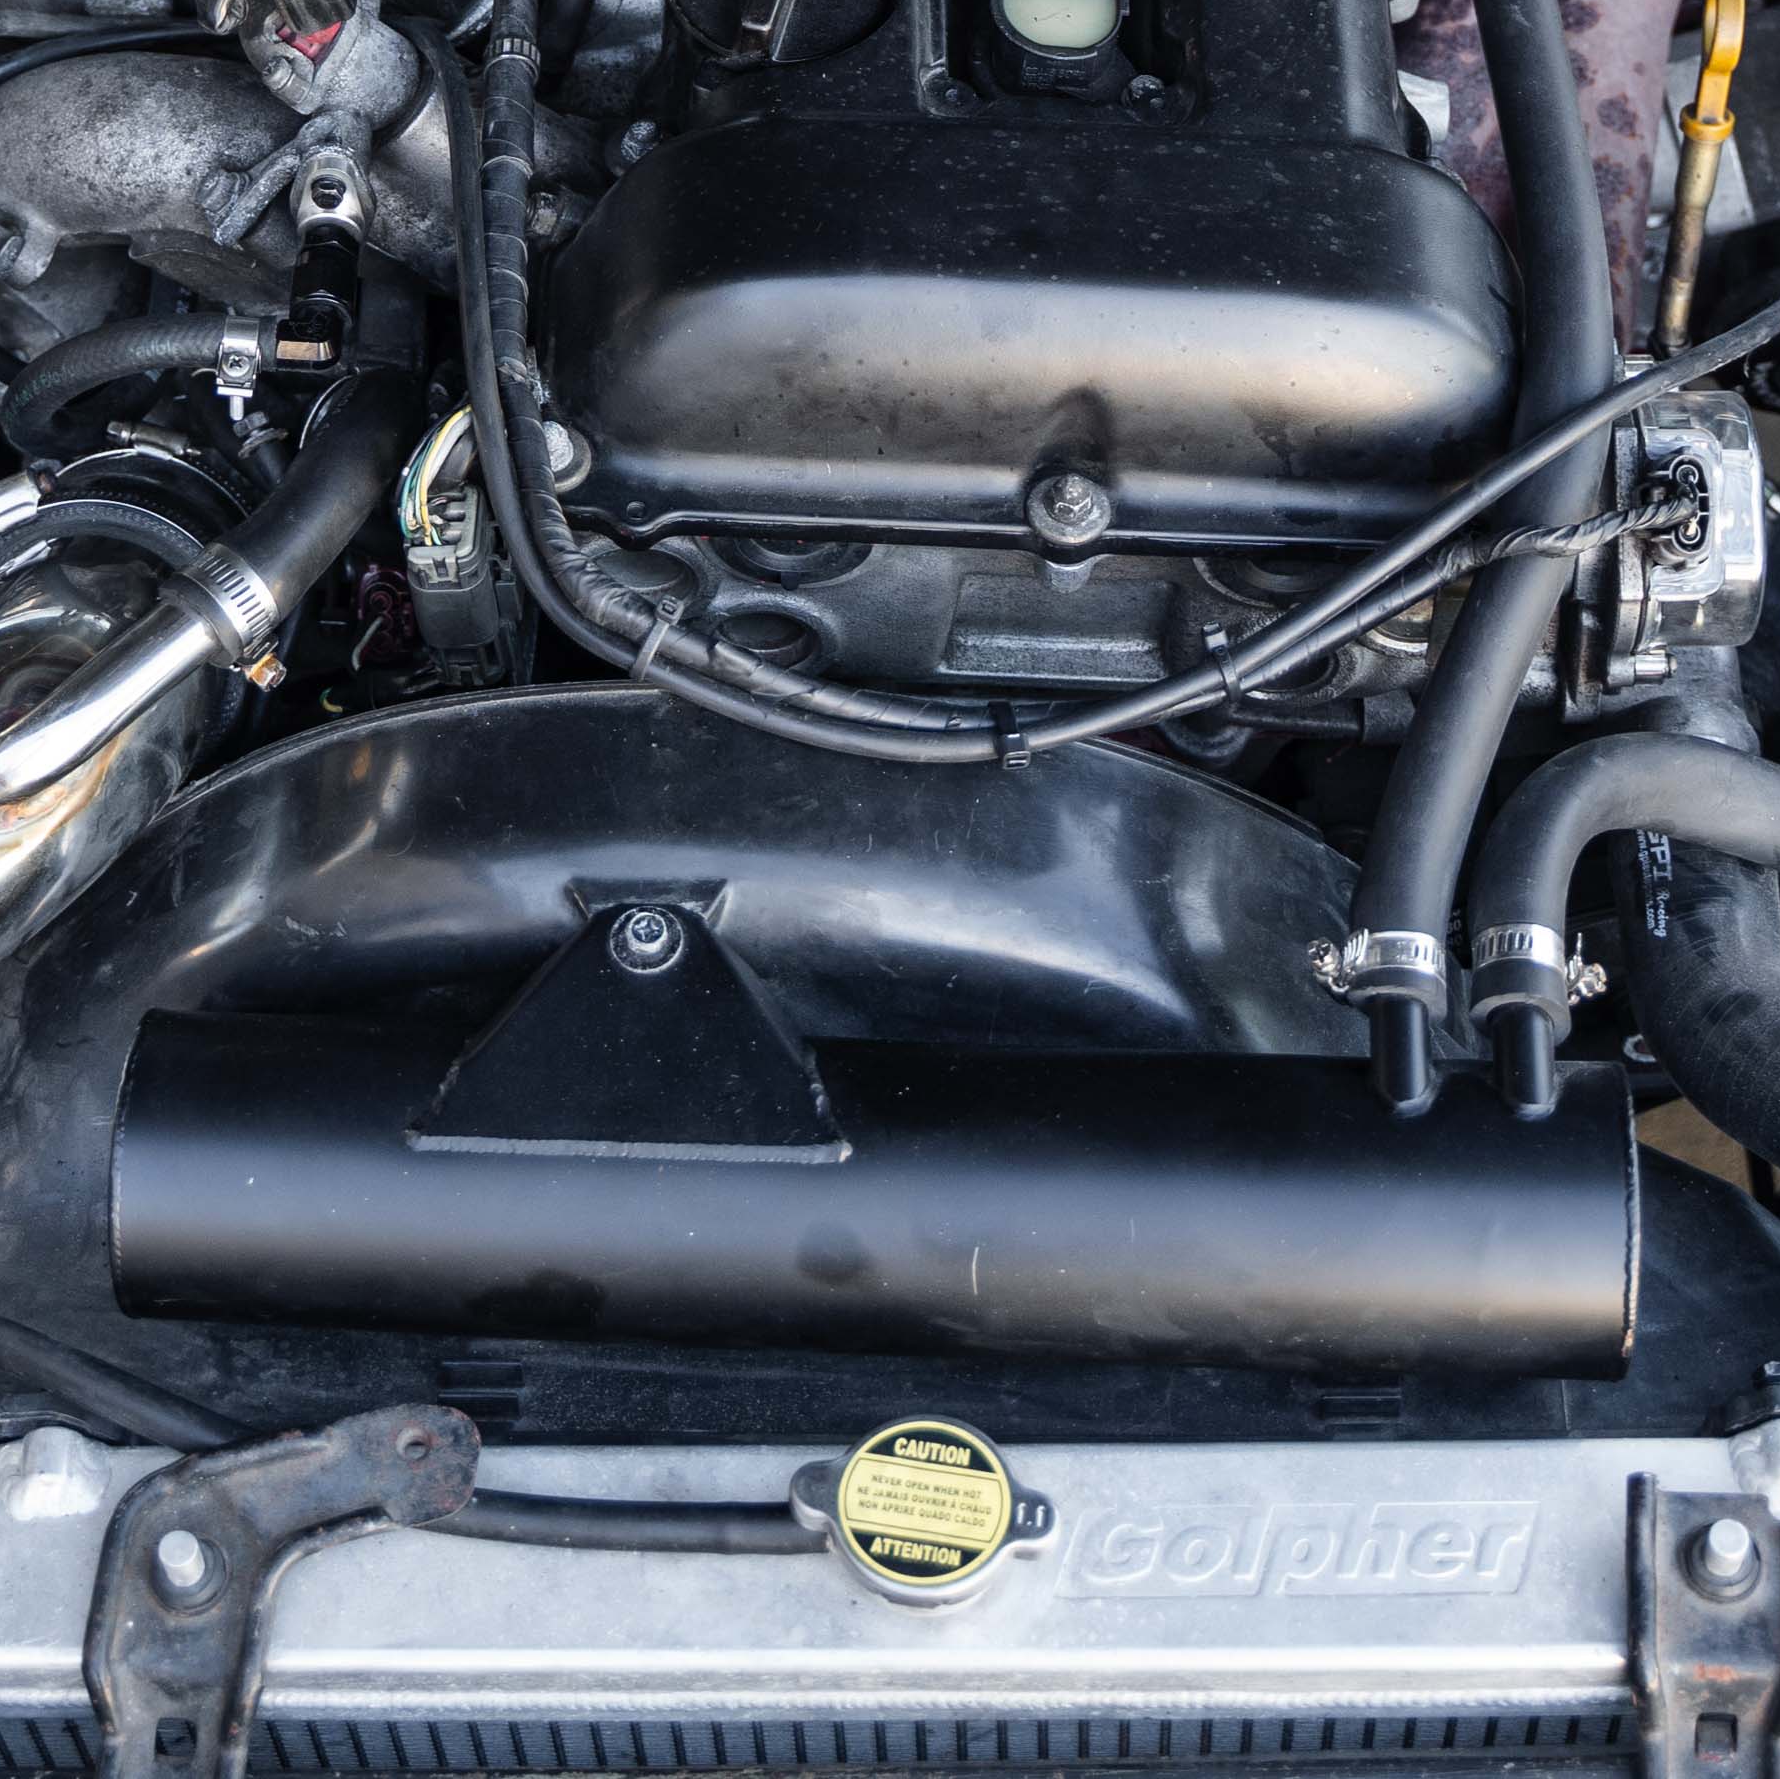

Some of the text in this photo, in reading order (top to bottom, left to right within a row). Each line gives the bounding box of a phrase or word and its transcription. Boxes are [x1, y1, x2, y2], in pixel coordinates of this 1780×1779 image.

[1652, 890, 1671, 938] Racing
[894, 1436, 971, 1466] CAUTION
[857, 1485, 869, 1496] NE
[873, 1488, 909, 1502] JAMAIS
[911, 1493, 947, 1508] OUVRIR
[960, 1502, 992, 1516] CHAUD
[871, 1474, 982, 1498] NEVER OPEN WHEN HOT
[859, 1500, 987, 1528] NON APRIRE QUADO CALDO
[870, 1536, 962, 1566] ATTENTION
[1082, 1502, 1533, 1595] Golpher
